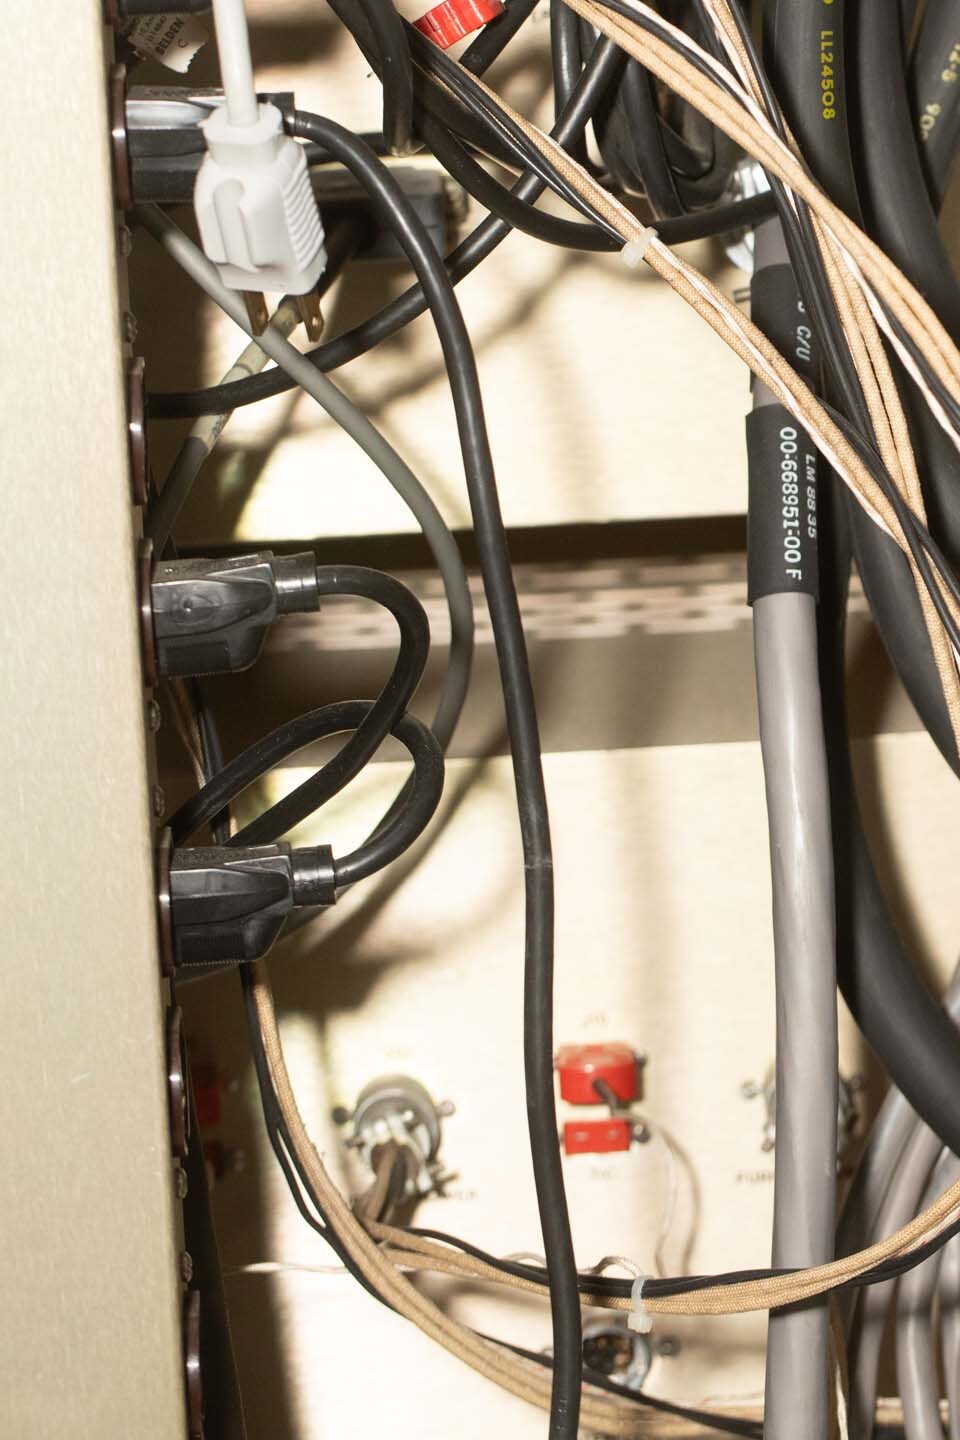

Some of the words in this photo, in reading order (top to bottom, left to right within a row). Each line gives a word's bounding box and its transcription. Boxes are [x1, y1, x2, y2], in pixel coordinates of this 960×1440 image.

[155, 17, 185, 56] BELDEN
[820, 30, 836, 120] LL24508
[805, 453, 817, 481] LM
[785, 568, 802, 581] F
